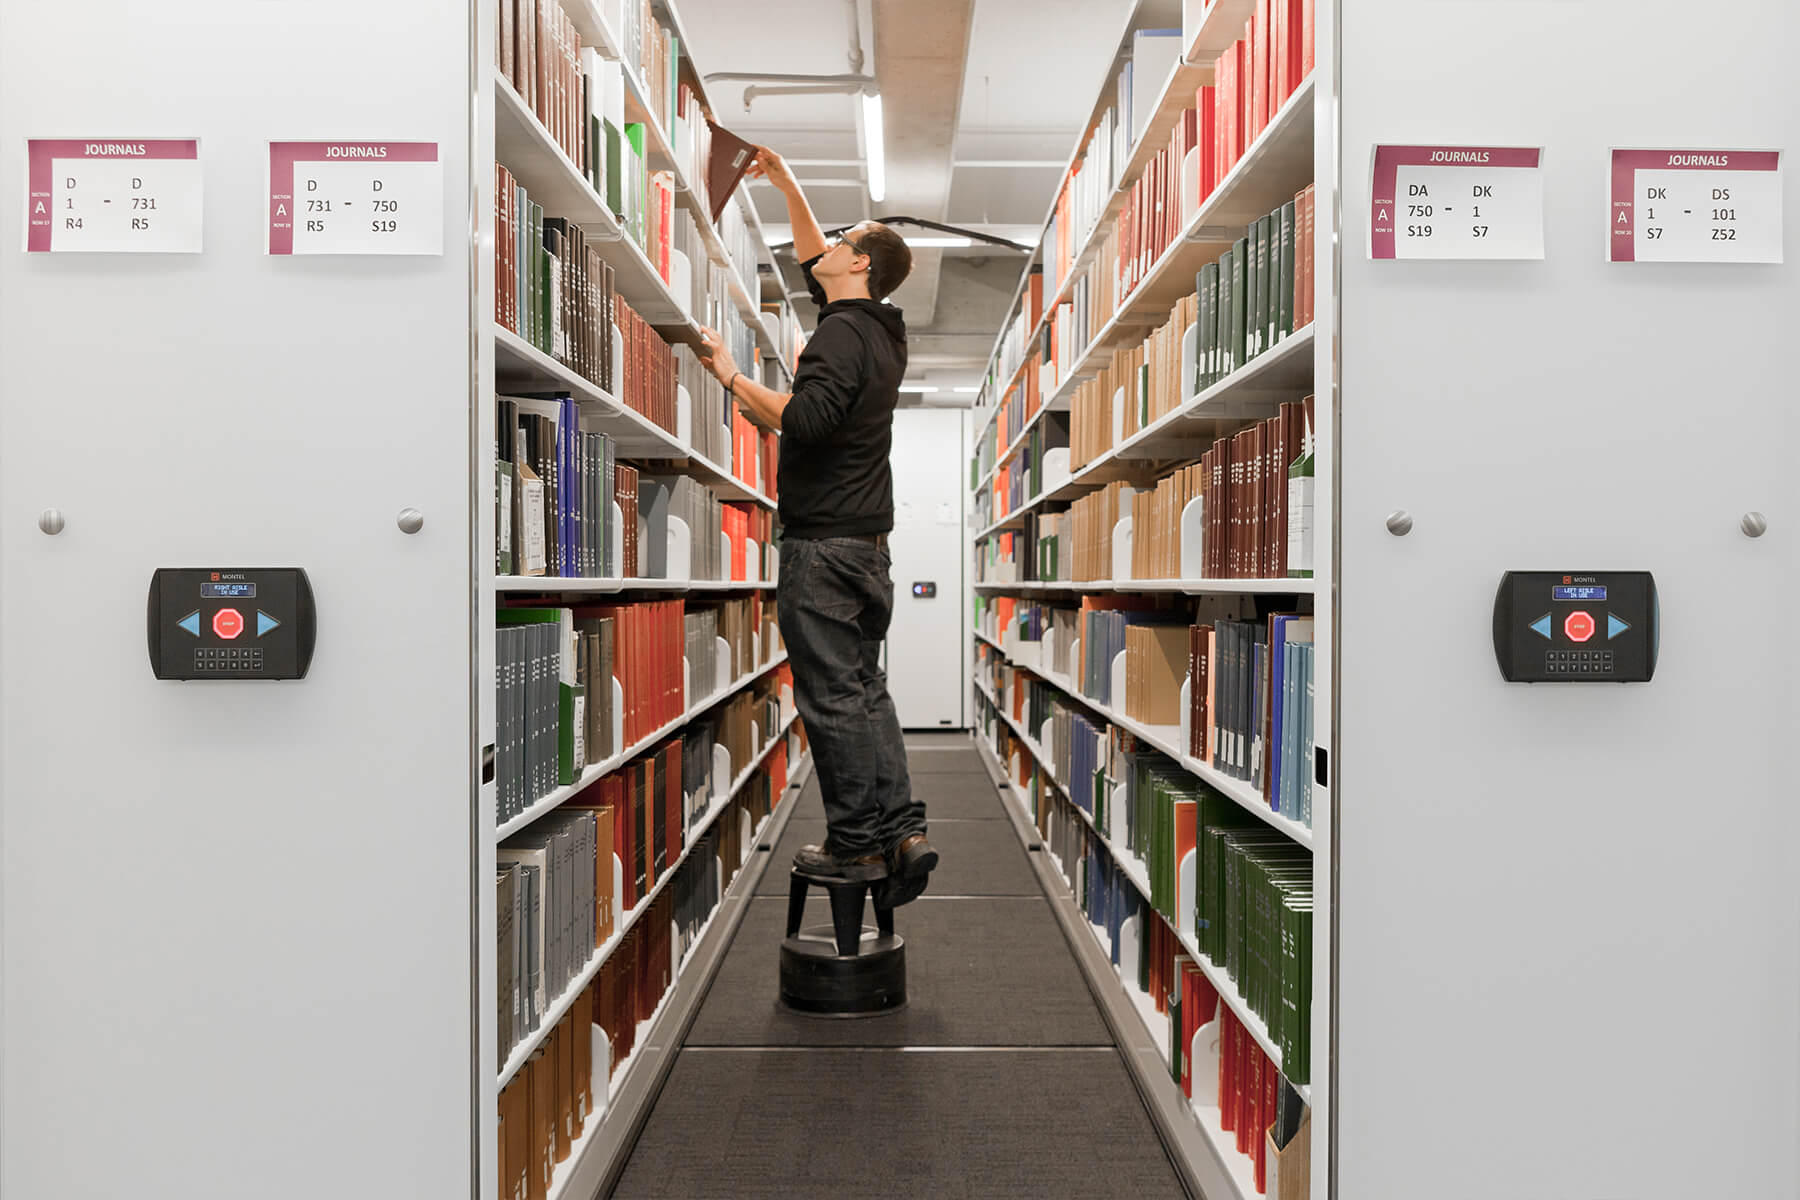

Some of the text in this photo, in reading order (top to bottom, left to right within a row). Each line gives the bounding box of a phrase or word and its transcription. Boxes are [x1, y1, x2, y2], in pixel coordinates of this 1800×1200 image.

[85, 144, 146, 155] JOURNALS
[326, 147, 387, 157] JOURNALS
[1430, 151, 1489, 162] JOURNALS
[1667, 155, 1728, 166] JOURNALS
[66, 178, 142, 189] D D
[307, 180, 382, 191] D D
[1409, 185, 1492, 197] DA DK
[1648, 188, 1729, 200] DK DS
[35, 201, 46, 214] A
[67, 198, 73, 209] 1
[131, 198, 156, 209] 731
[307, 201, 332, 212] 731
[372, 201, 398, 212] 750
[276, 204, 287, 216] A
[1378, 209, 1388, 221] A
[1408, 206, 1433, 217] 750
[1473, 207, 1480, 217] 1
[1648, 208, 1655, 219] 1
[1712, 209, 1736, 220] 101
[1617, 211, 1627, 223] A
[66, 218, 149, 229] R4 R5
[307, 221, 397, 232] R5 S19
[1408, 226, 1488, 237] S19 S7
[1648, 228, 1736, 240] S7 Z52
